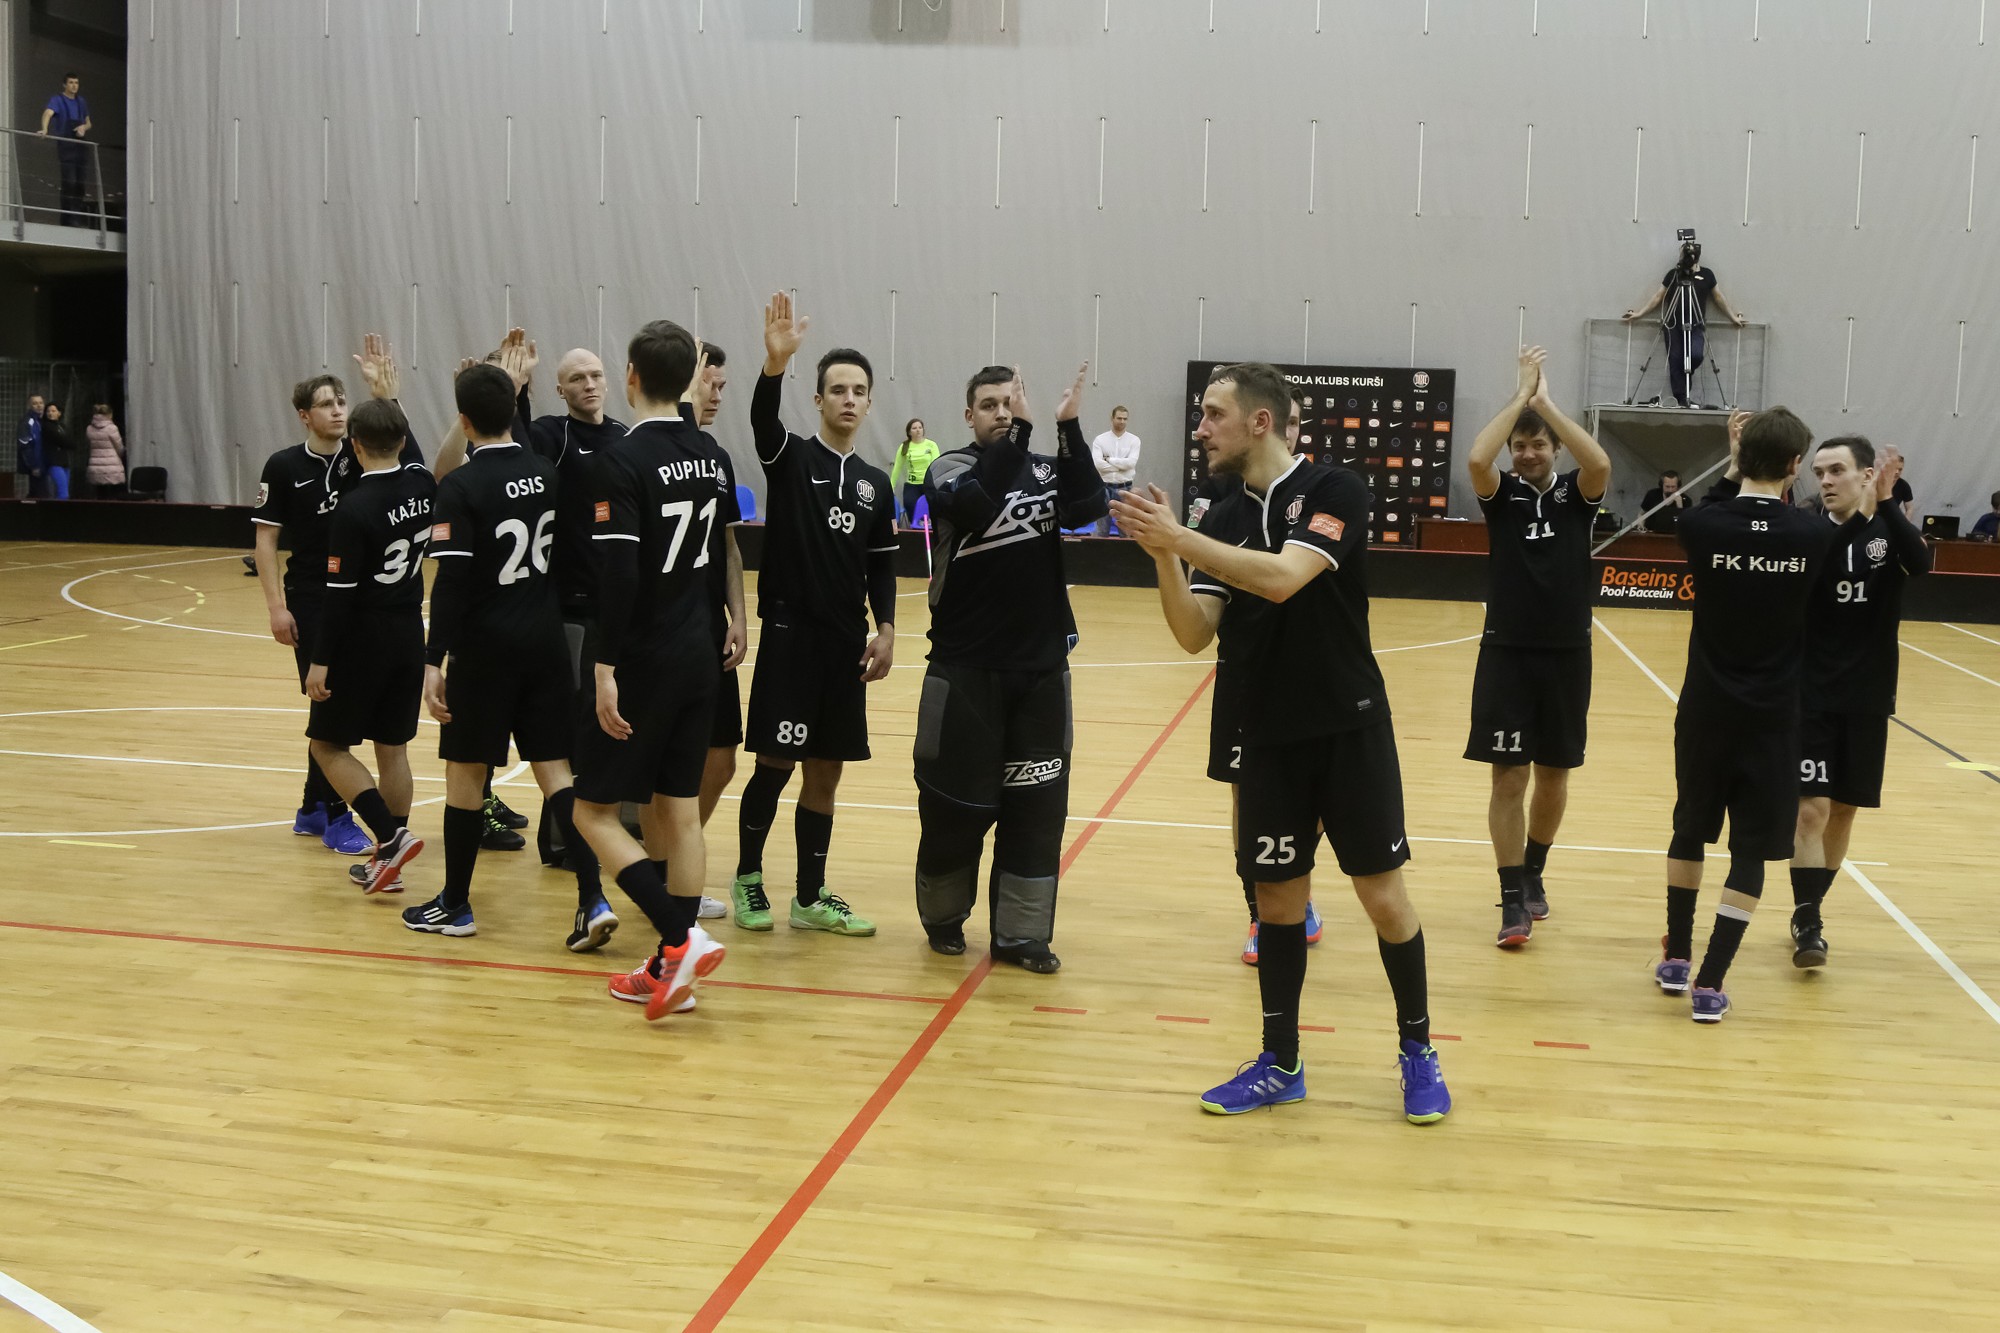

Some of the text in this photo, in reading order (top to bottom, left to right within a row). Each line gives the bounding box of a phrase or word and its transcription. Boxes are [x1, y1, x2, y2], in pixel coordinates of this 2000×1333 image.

[1282, 374, 1384, 387] BOLA KLUBS KURŠI
[657, 458, 717, 486] PUPILS
[505, 475, 545, 499] OSIS
[317, 490, 339, 515] 15
[387, 498, 430, 527] KAŽIS
[828, 506, 856, 534] 89
[1525, 521, 1555, 540] 11
[1751, 520, 1769, 532] 93
[494, 509, 556, 586] 26
[661, 497, 717, 574] 71
[373, 525, 433, 585] 37
[1712, 553, 1807, 574] FK Kurši
[1601, 566, 1695, 601] Baseins &
[1836, 580, 1868, 603] 91
[776, 720, 808, 746] 89
[1492, 730, 1522, 752] 11
[1003, 758, 1063, 787] Zone
[1800, 759, 1829, 783] 91
[1255, 835, 1297, 865] 25
